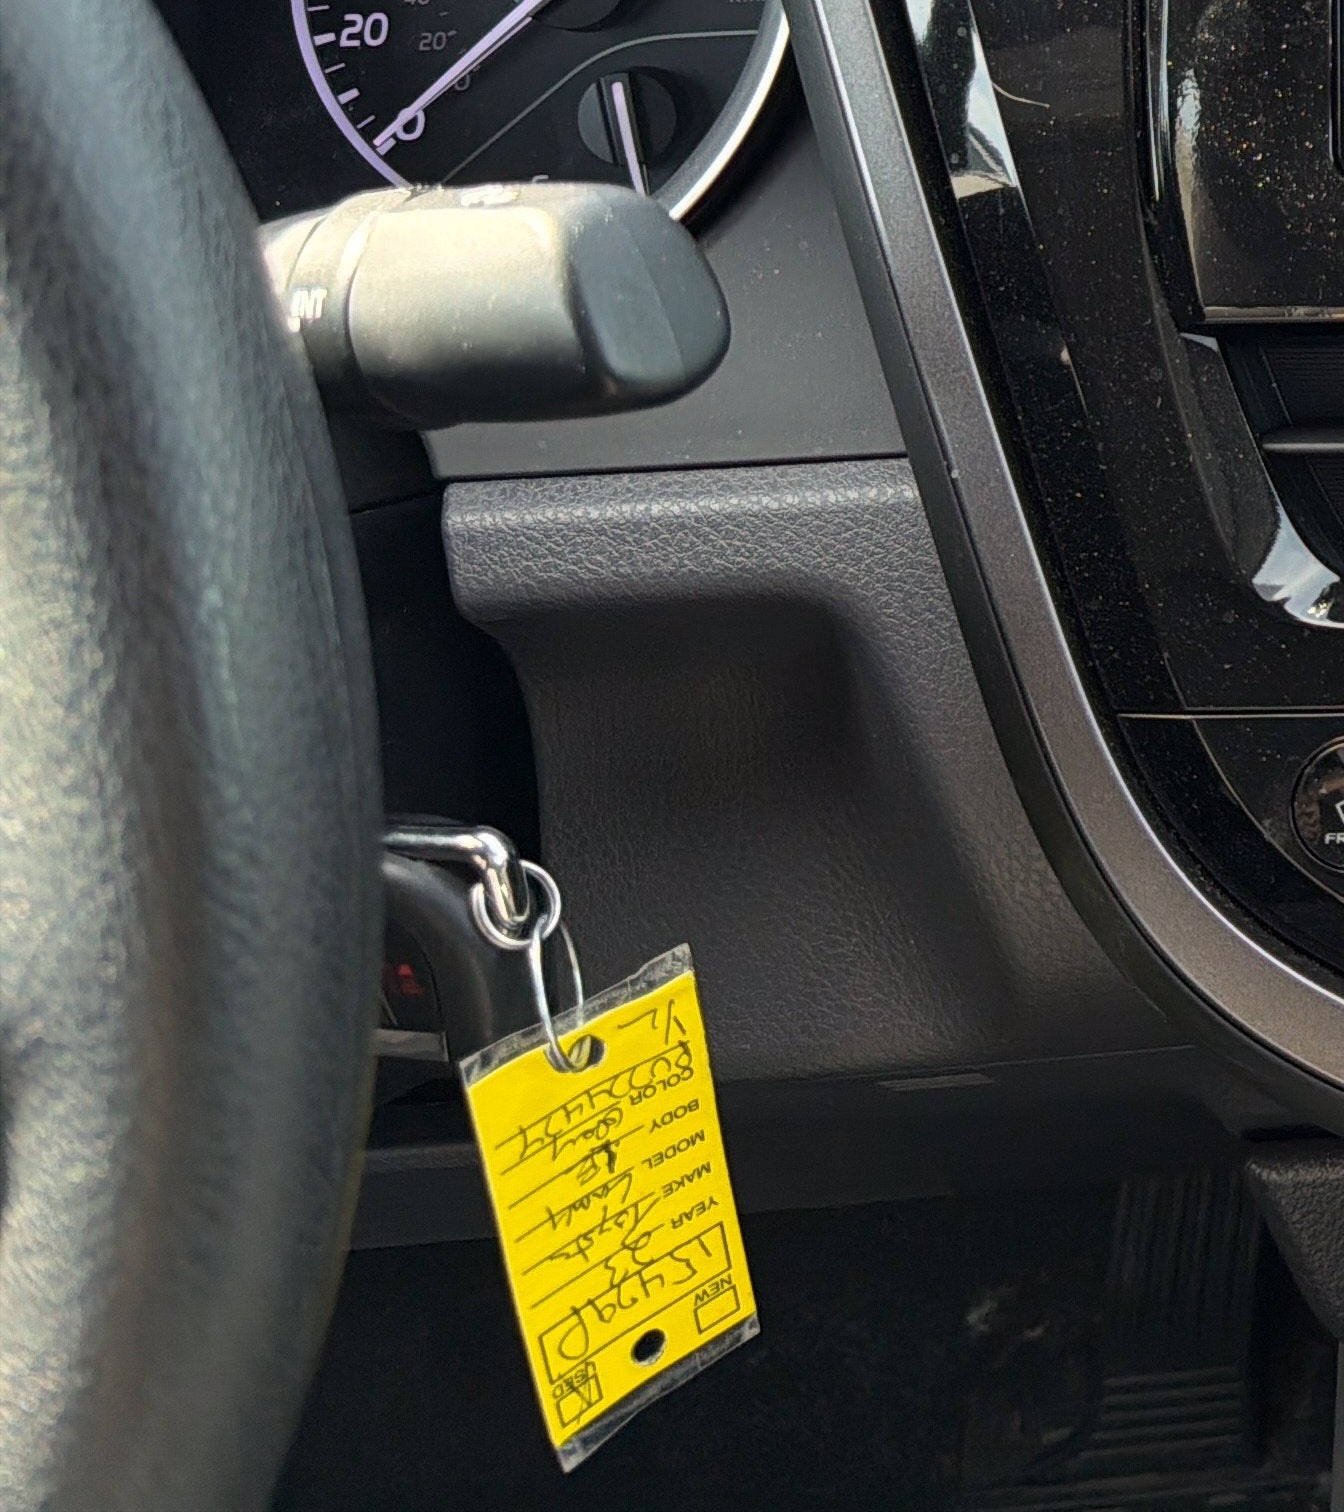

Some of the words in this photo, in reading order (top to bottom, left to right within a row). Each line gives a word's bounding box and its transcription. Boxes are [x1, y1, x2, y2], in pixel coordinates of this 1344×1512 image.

[339, 13, 389, 48] 20
[418, 32, 447, 52] 20
[629, 1066, 695, 1106] COLOR
[649, 1098, 700, 1133] BODY
[641, 1129, 706, 1170] MODEL
[661, 1161, 712, 1199] MAKE
[671, 1195, 719, 1230] YEAR
[693, 1273, 733, 1307] NEW
